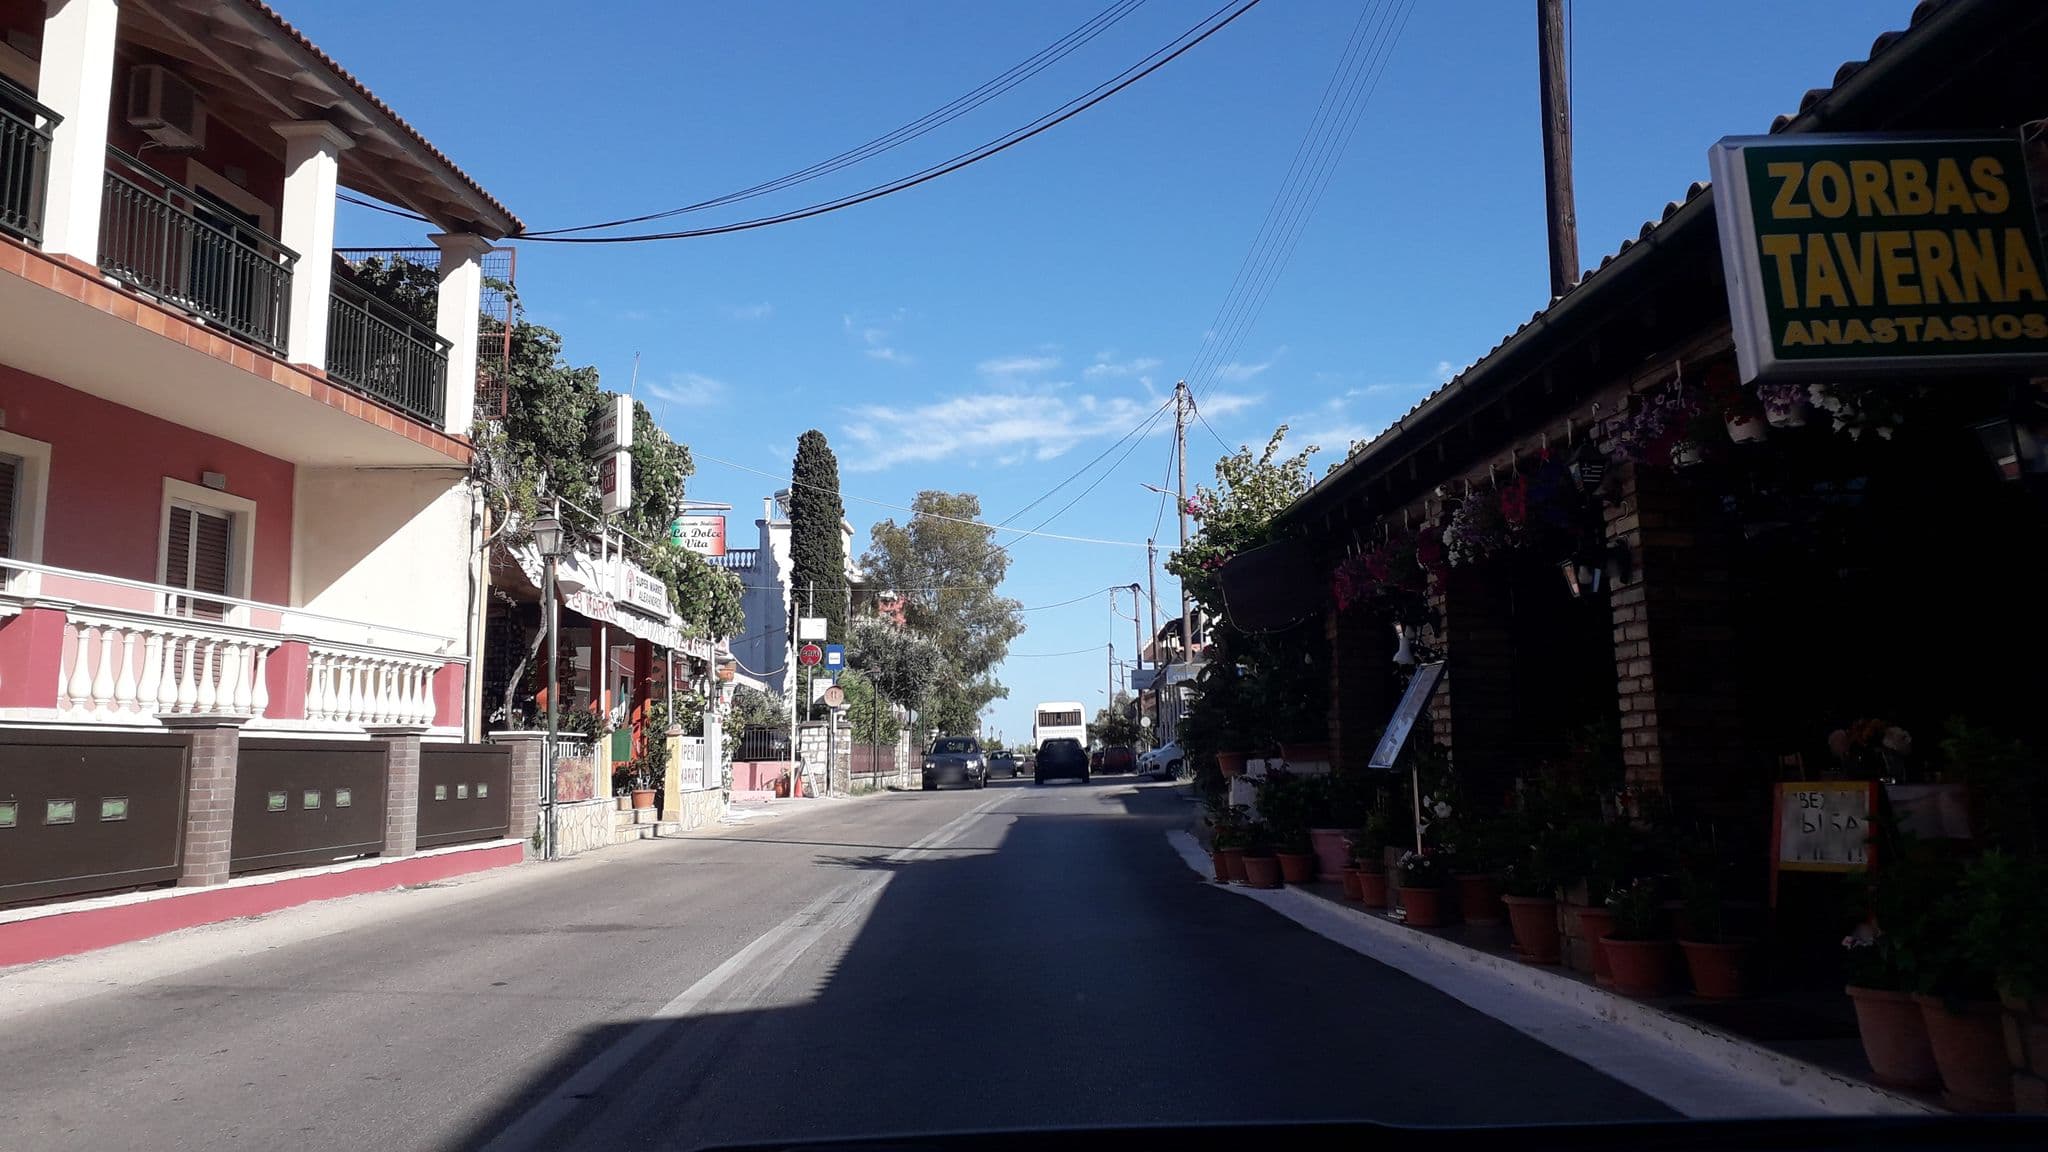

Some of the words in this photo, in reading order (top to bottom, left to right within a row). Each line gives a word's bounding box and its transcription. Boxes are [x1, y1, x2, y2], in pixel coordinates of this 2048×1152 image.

[1766, 156, 2011, 220] ZORBAS
[1761, 229, 2047, 309] TAVERNA
[1782, 313, 2047, 346] ANASTASIOS
[672, 528, 687, 538] La
[691, 528, 722, 538] Dolce
[684, 538, 709, 548] Vita
[635, 575, 649, 590] SUPER
